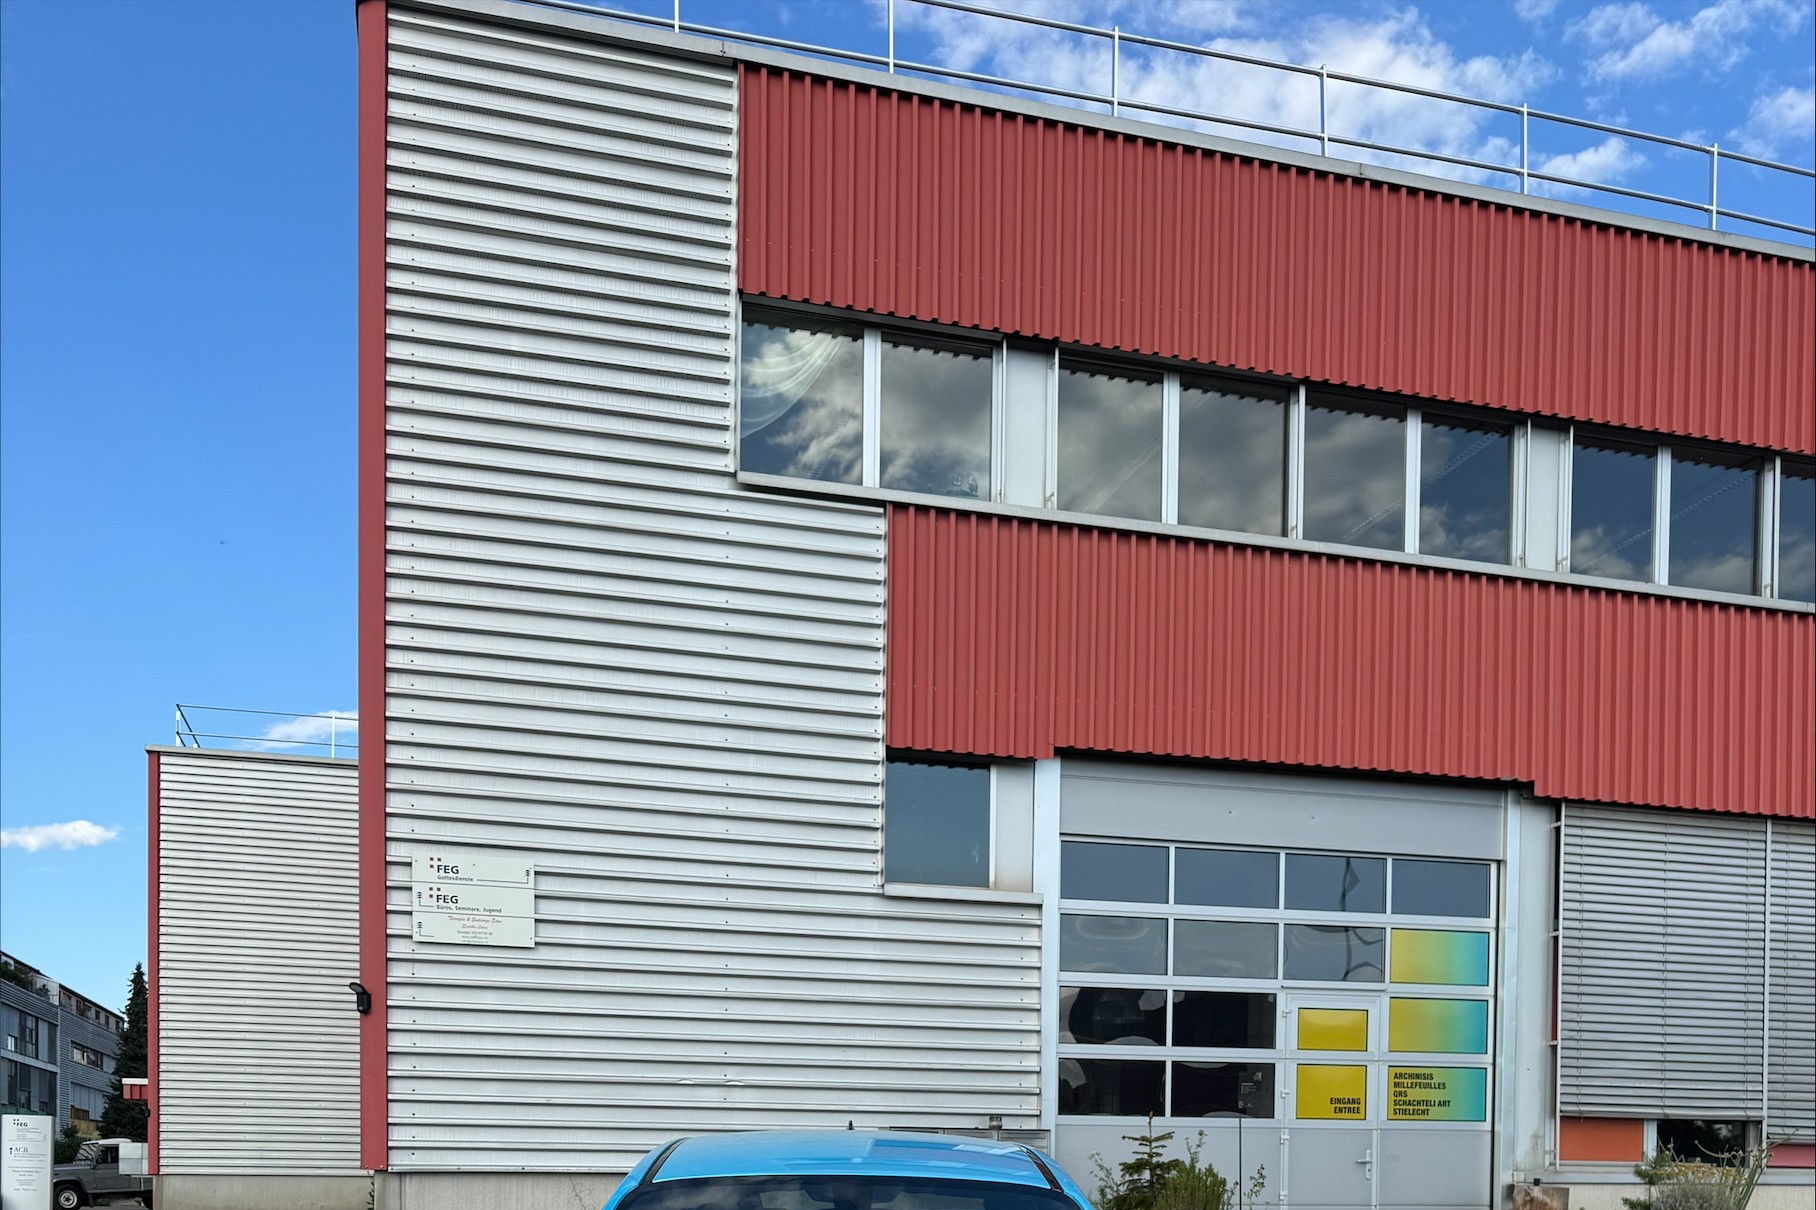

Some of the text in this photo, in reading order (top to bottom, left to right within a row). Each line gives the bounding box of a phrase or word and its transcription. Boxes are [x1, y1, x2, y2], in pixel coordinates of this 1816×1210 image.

[437, 865, 459, 874] FEG
[436, 894, 459, 904] FEG
[1393, 1072, 1434, 1081] ARCHINISIS
[1394, 1082, 1447, 1090] MILLEFEUILLES
[1393, 1090, 1408, 1099] QRS
[1329, 1097, 1361, 1106] EINGANG
[1393, 1099, 1451, 1108] SCHACHTELI ART
[1334, 1106, 1361, 1115] ENTREE
[1392, 1107, 1430, 1116] STIELECHT
